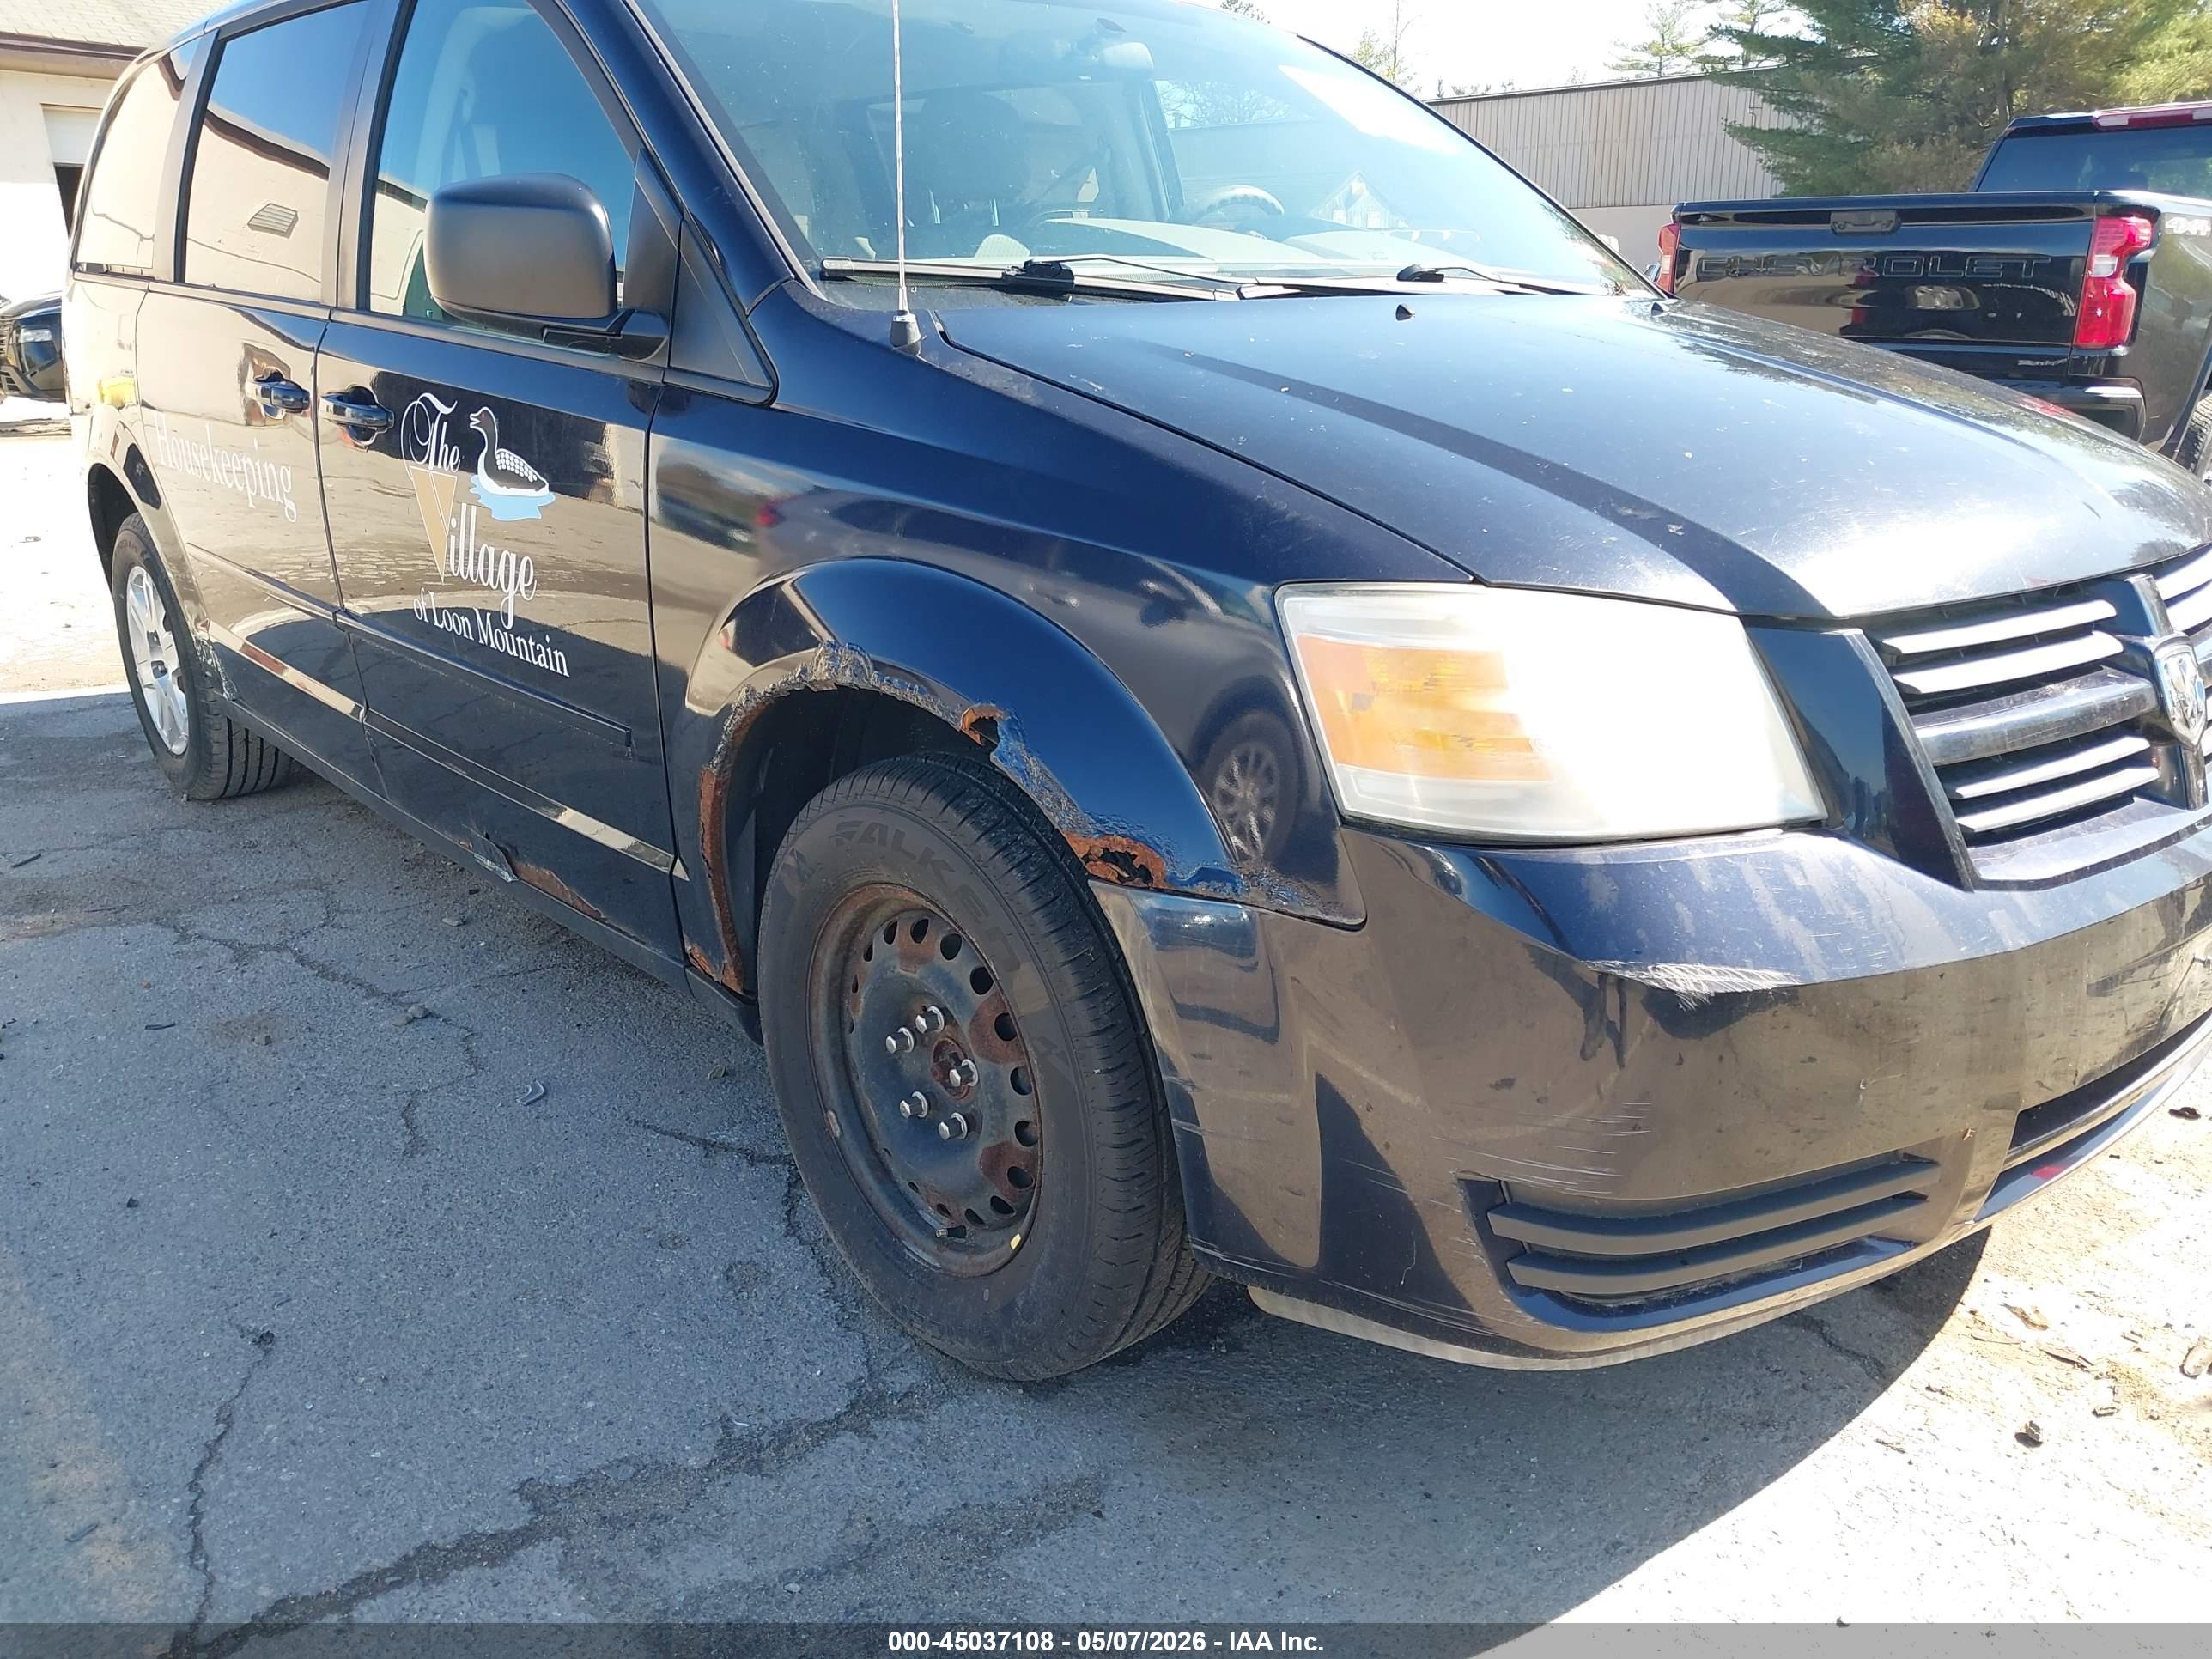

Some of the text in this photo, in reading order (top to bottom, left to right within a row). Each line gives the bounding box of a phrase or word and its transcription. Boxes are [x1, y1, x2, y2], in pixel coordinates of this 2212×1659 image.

[153, 411, 297, 523] Housekeeping
[401, 392, 460, 482] The
[409, 466, 538, 629] Village
[413, 587, 570, 678] of Loon Mountain
